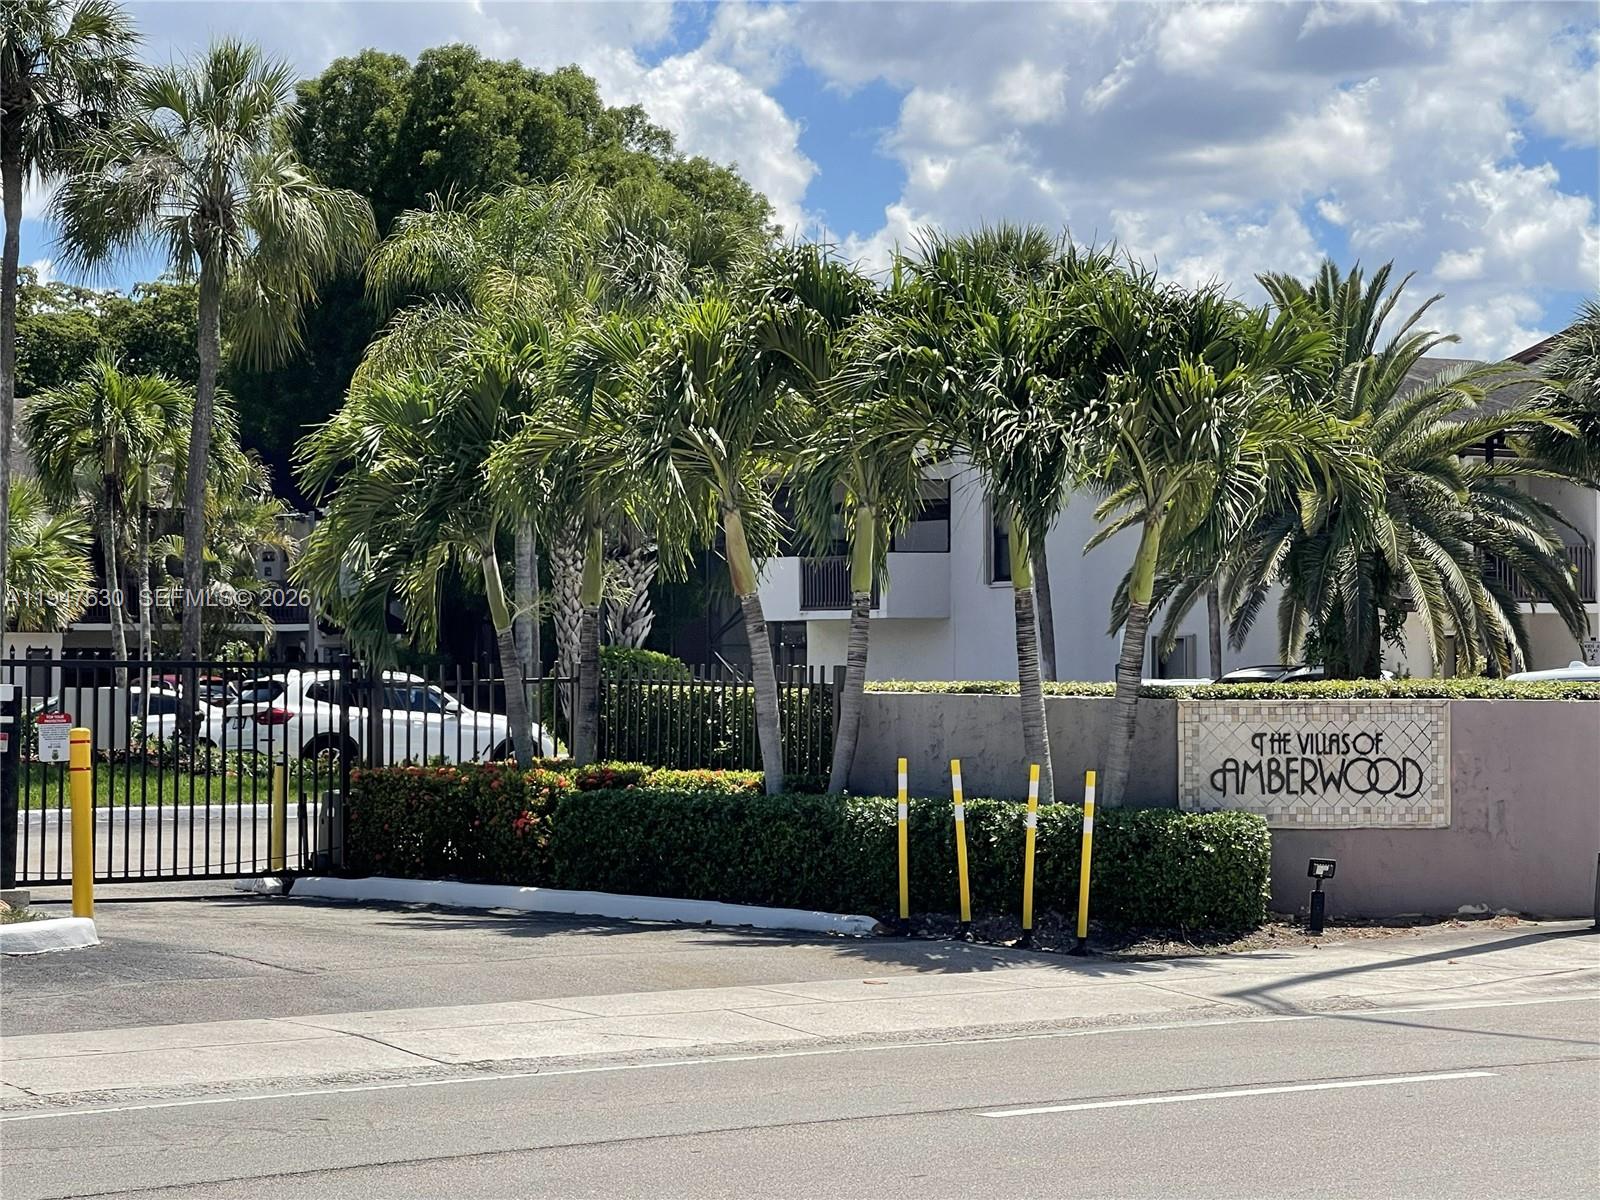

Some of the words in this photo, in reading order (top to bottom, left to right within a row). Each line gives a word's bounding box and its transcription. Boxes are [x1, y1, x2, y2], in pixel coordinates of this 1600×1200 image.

[1251, 732, 1291, 756] THE
[1297, 732, 1351, 756] VILLAS
[1352, 732, 1384, 755] OF
[1210, 757, 1424, 798] AMBERWOOD
